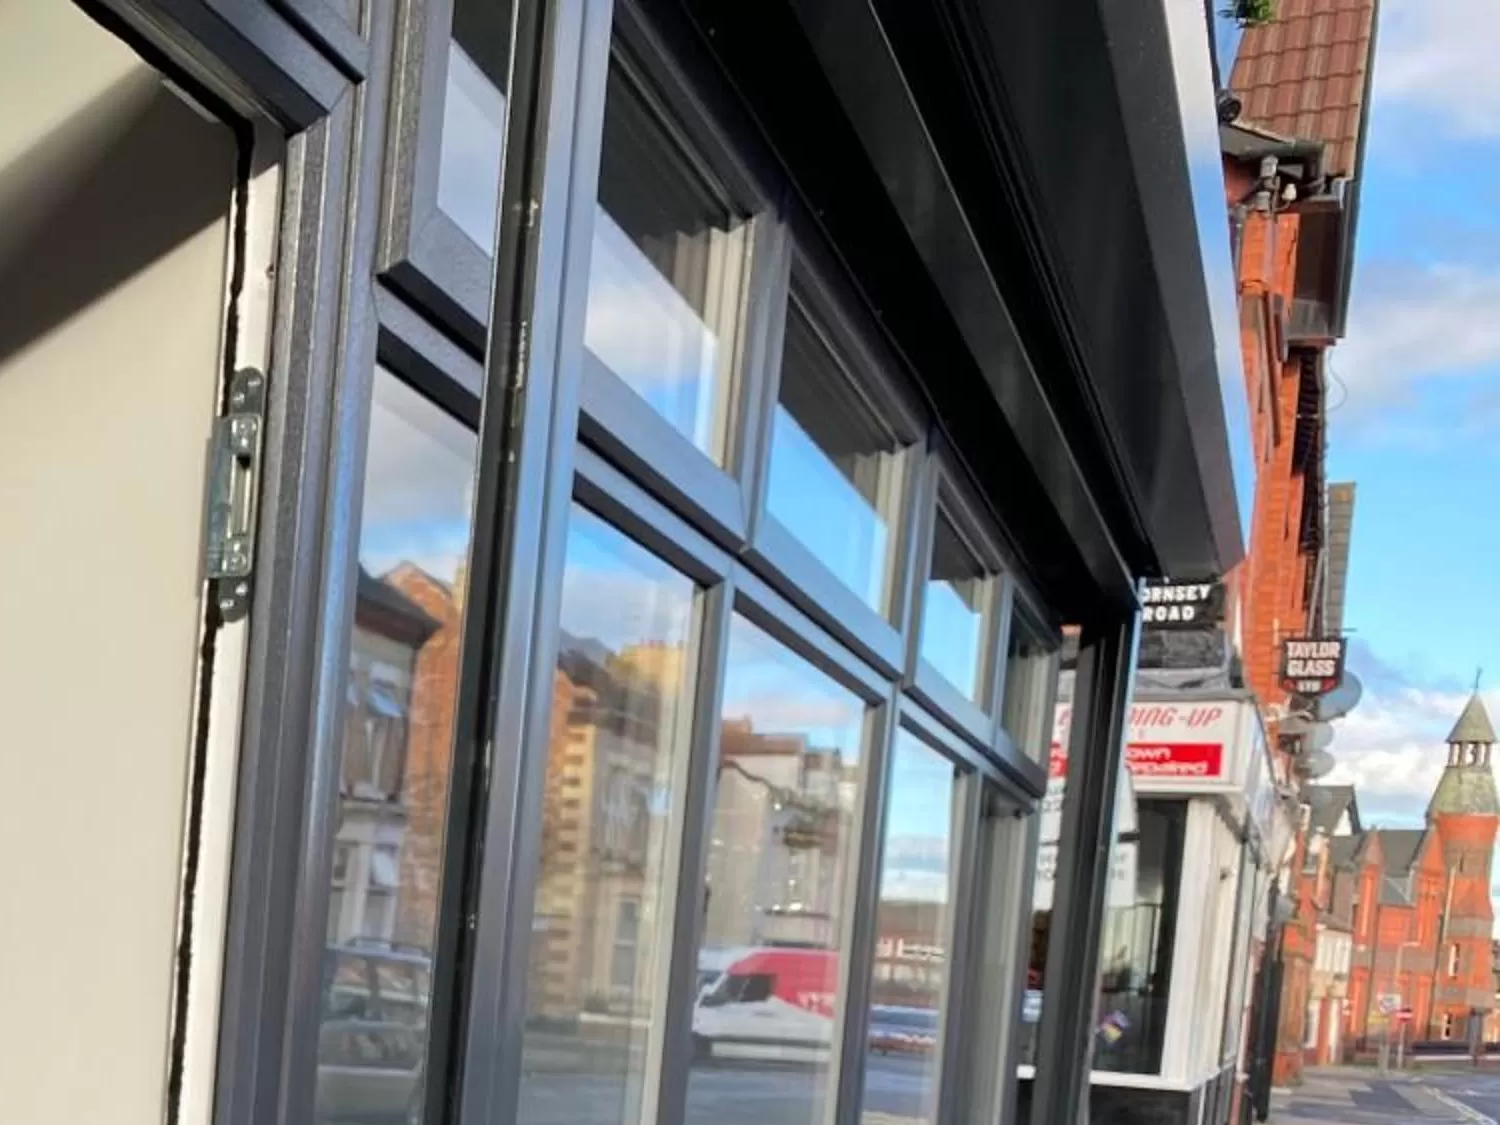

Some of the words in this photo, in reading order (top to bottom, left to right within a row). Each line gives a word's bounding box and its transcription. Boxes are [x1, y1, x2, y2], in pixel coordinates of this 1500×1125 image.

[1142, 605, 1195, 622] ROAD
[1286, 641, 1341, 659] TAYLOR
[1286, 660, 1336, 676] GLASS
